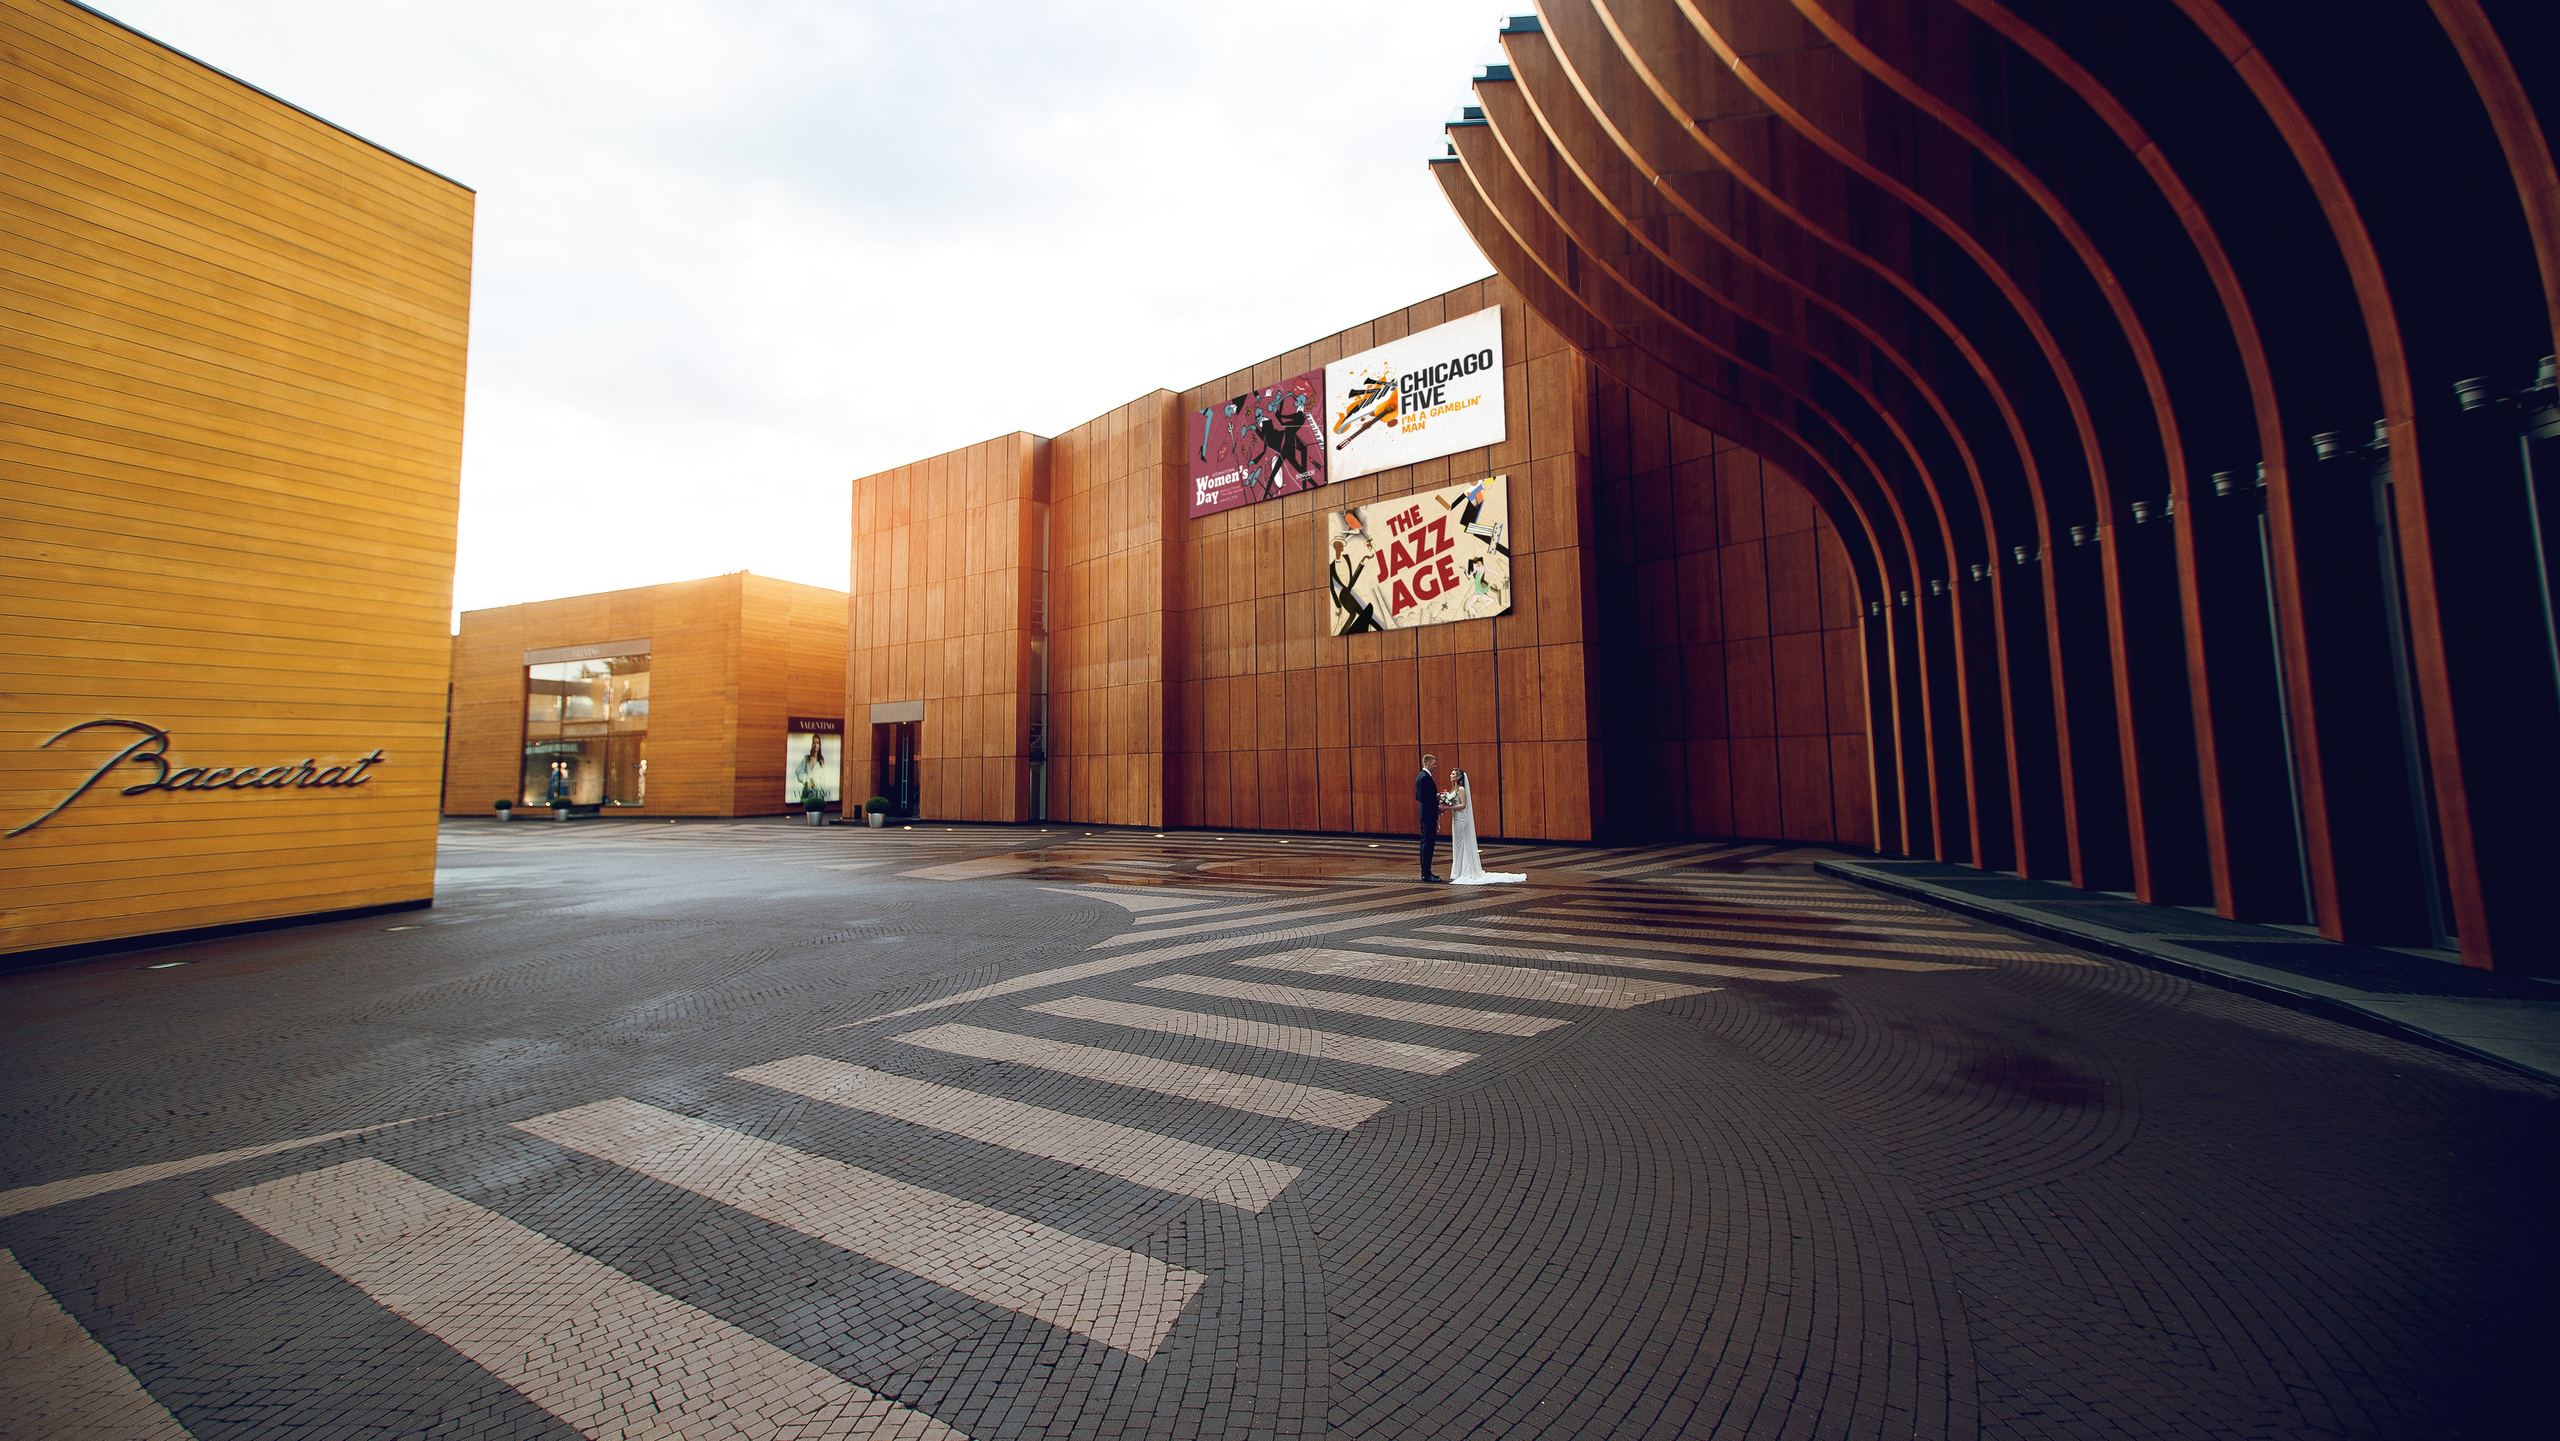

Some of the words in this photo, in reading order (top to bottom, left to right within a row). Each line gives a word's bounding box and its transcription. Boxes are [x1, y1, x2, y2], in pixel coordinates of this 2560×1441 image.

[1400, 348, 1493, 394] CHICAGO
[1401, 384, 1445, 414] FIVE
[1401, 413, 1417, 425] I'M
[1419, 411, 1427, 421] A
[1429, 395, 1482, 417] GAMBLIN'
[1402, 421, 1426, 434] MAN
[1196, 465, 1248, 490] Women's
[1196, 490, 1219, 506] Day
[1386, 504, 1424, 537] THE
[1375, 515, 1455, 583] JAZZ
[1391, 554, 1460, 617] AGE
[799, 720, 835, 729] VALENTINO
[5, 718, 384, 838] Baccarat
